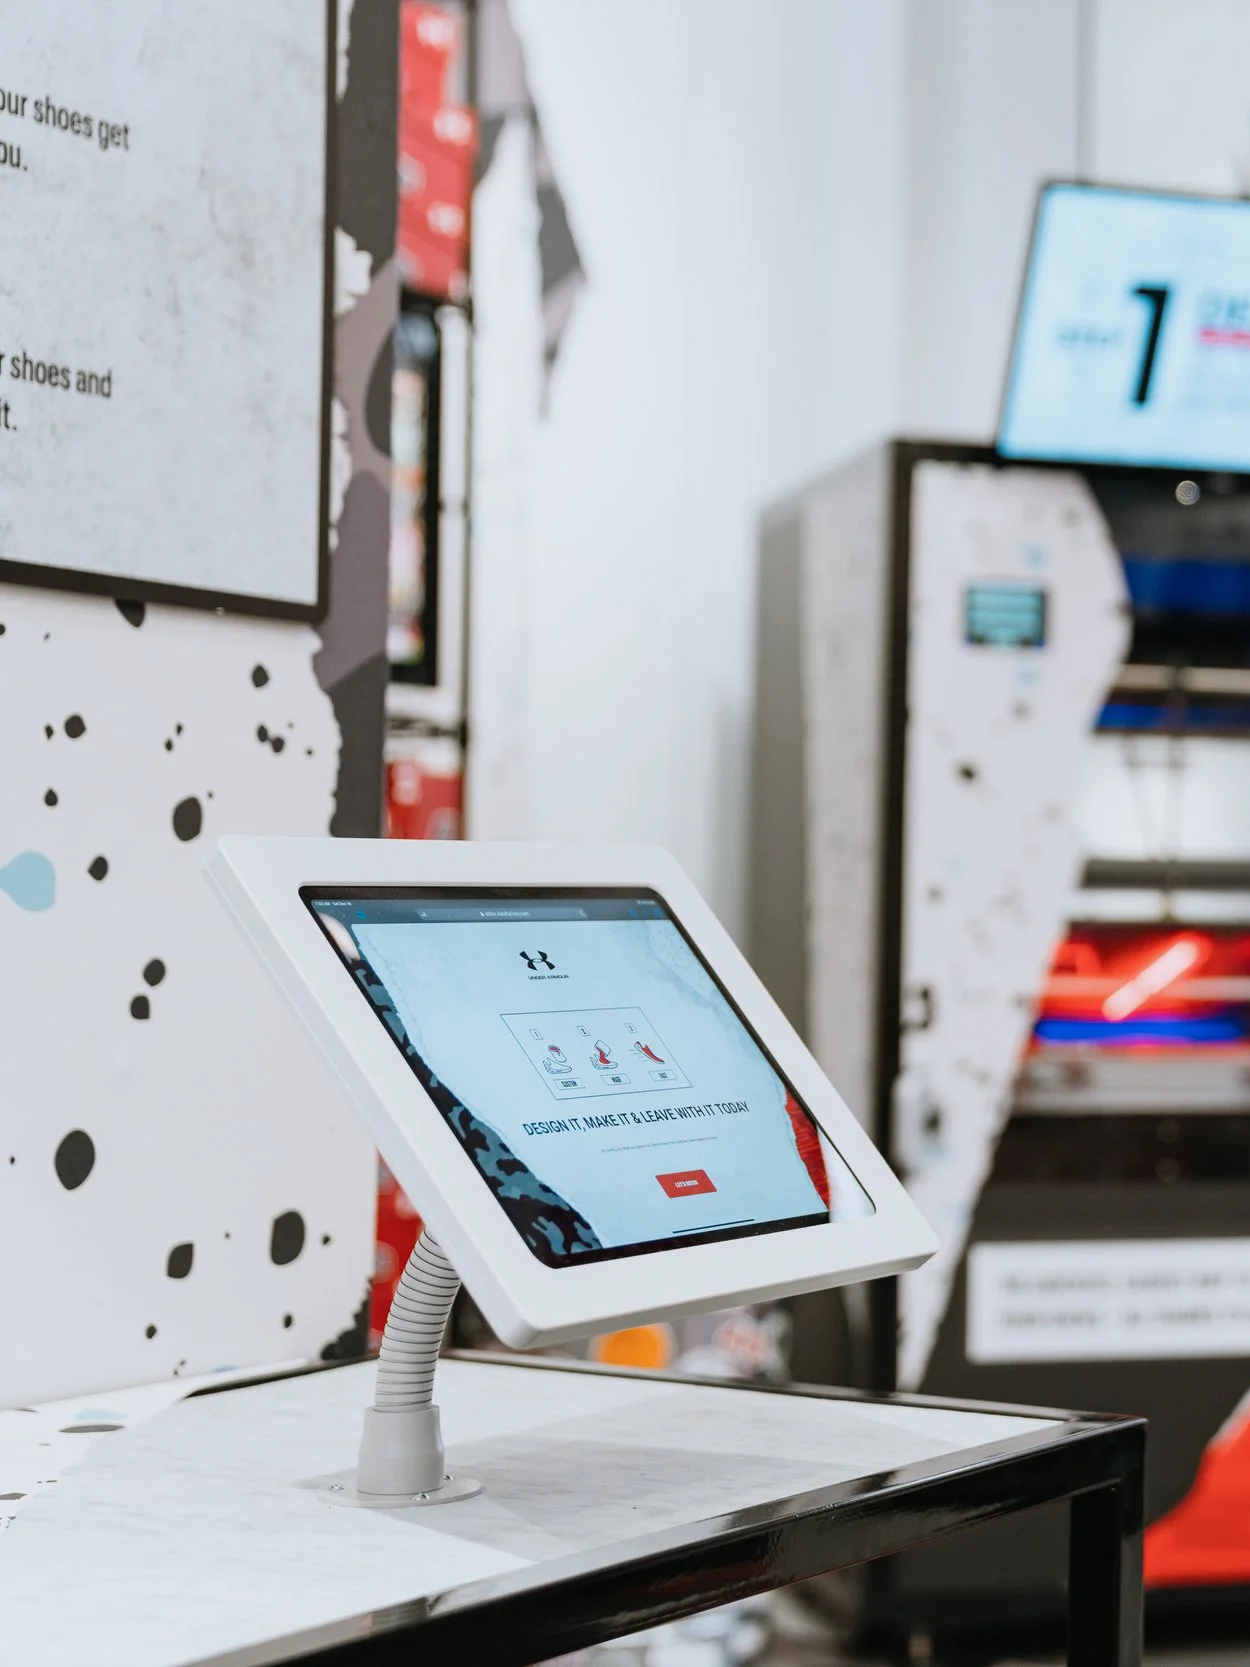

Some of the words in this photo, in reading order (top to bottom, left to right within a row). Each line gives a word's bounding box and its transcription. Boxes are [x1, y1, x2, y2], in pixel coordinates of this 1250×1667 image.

[33, 96, 93, 137] shoes
[98, 119, 129, 151] get
[1132, 285, 1170, 406] 1
[10, 350, 70, 390] shoes
[76, 369, 112, 398] and
[561, 1080, 578, 1088] CUSTOM
[522, 1119, 570, 1136] DESIGN
[568, 1118, 587, 1132] IT,
[582, 1114, 620, 1129] MAKE
[617, 1113, 631, 1125] IT
[630, 1112, 642, 1124] &
[640, 1108, 677, 1123] LEAVE
[674, 1105, 706, 1119] WITH
[703, 1104, 716, 1116] IT
[714, 1101, 750, 1115] TODAY
